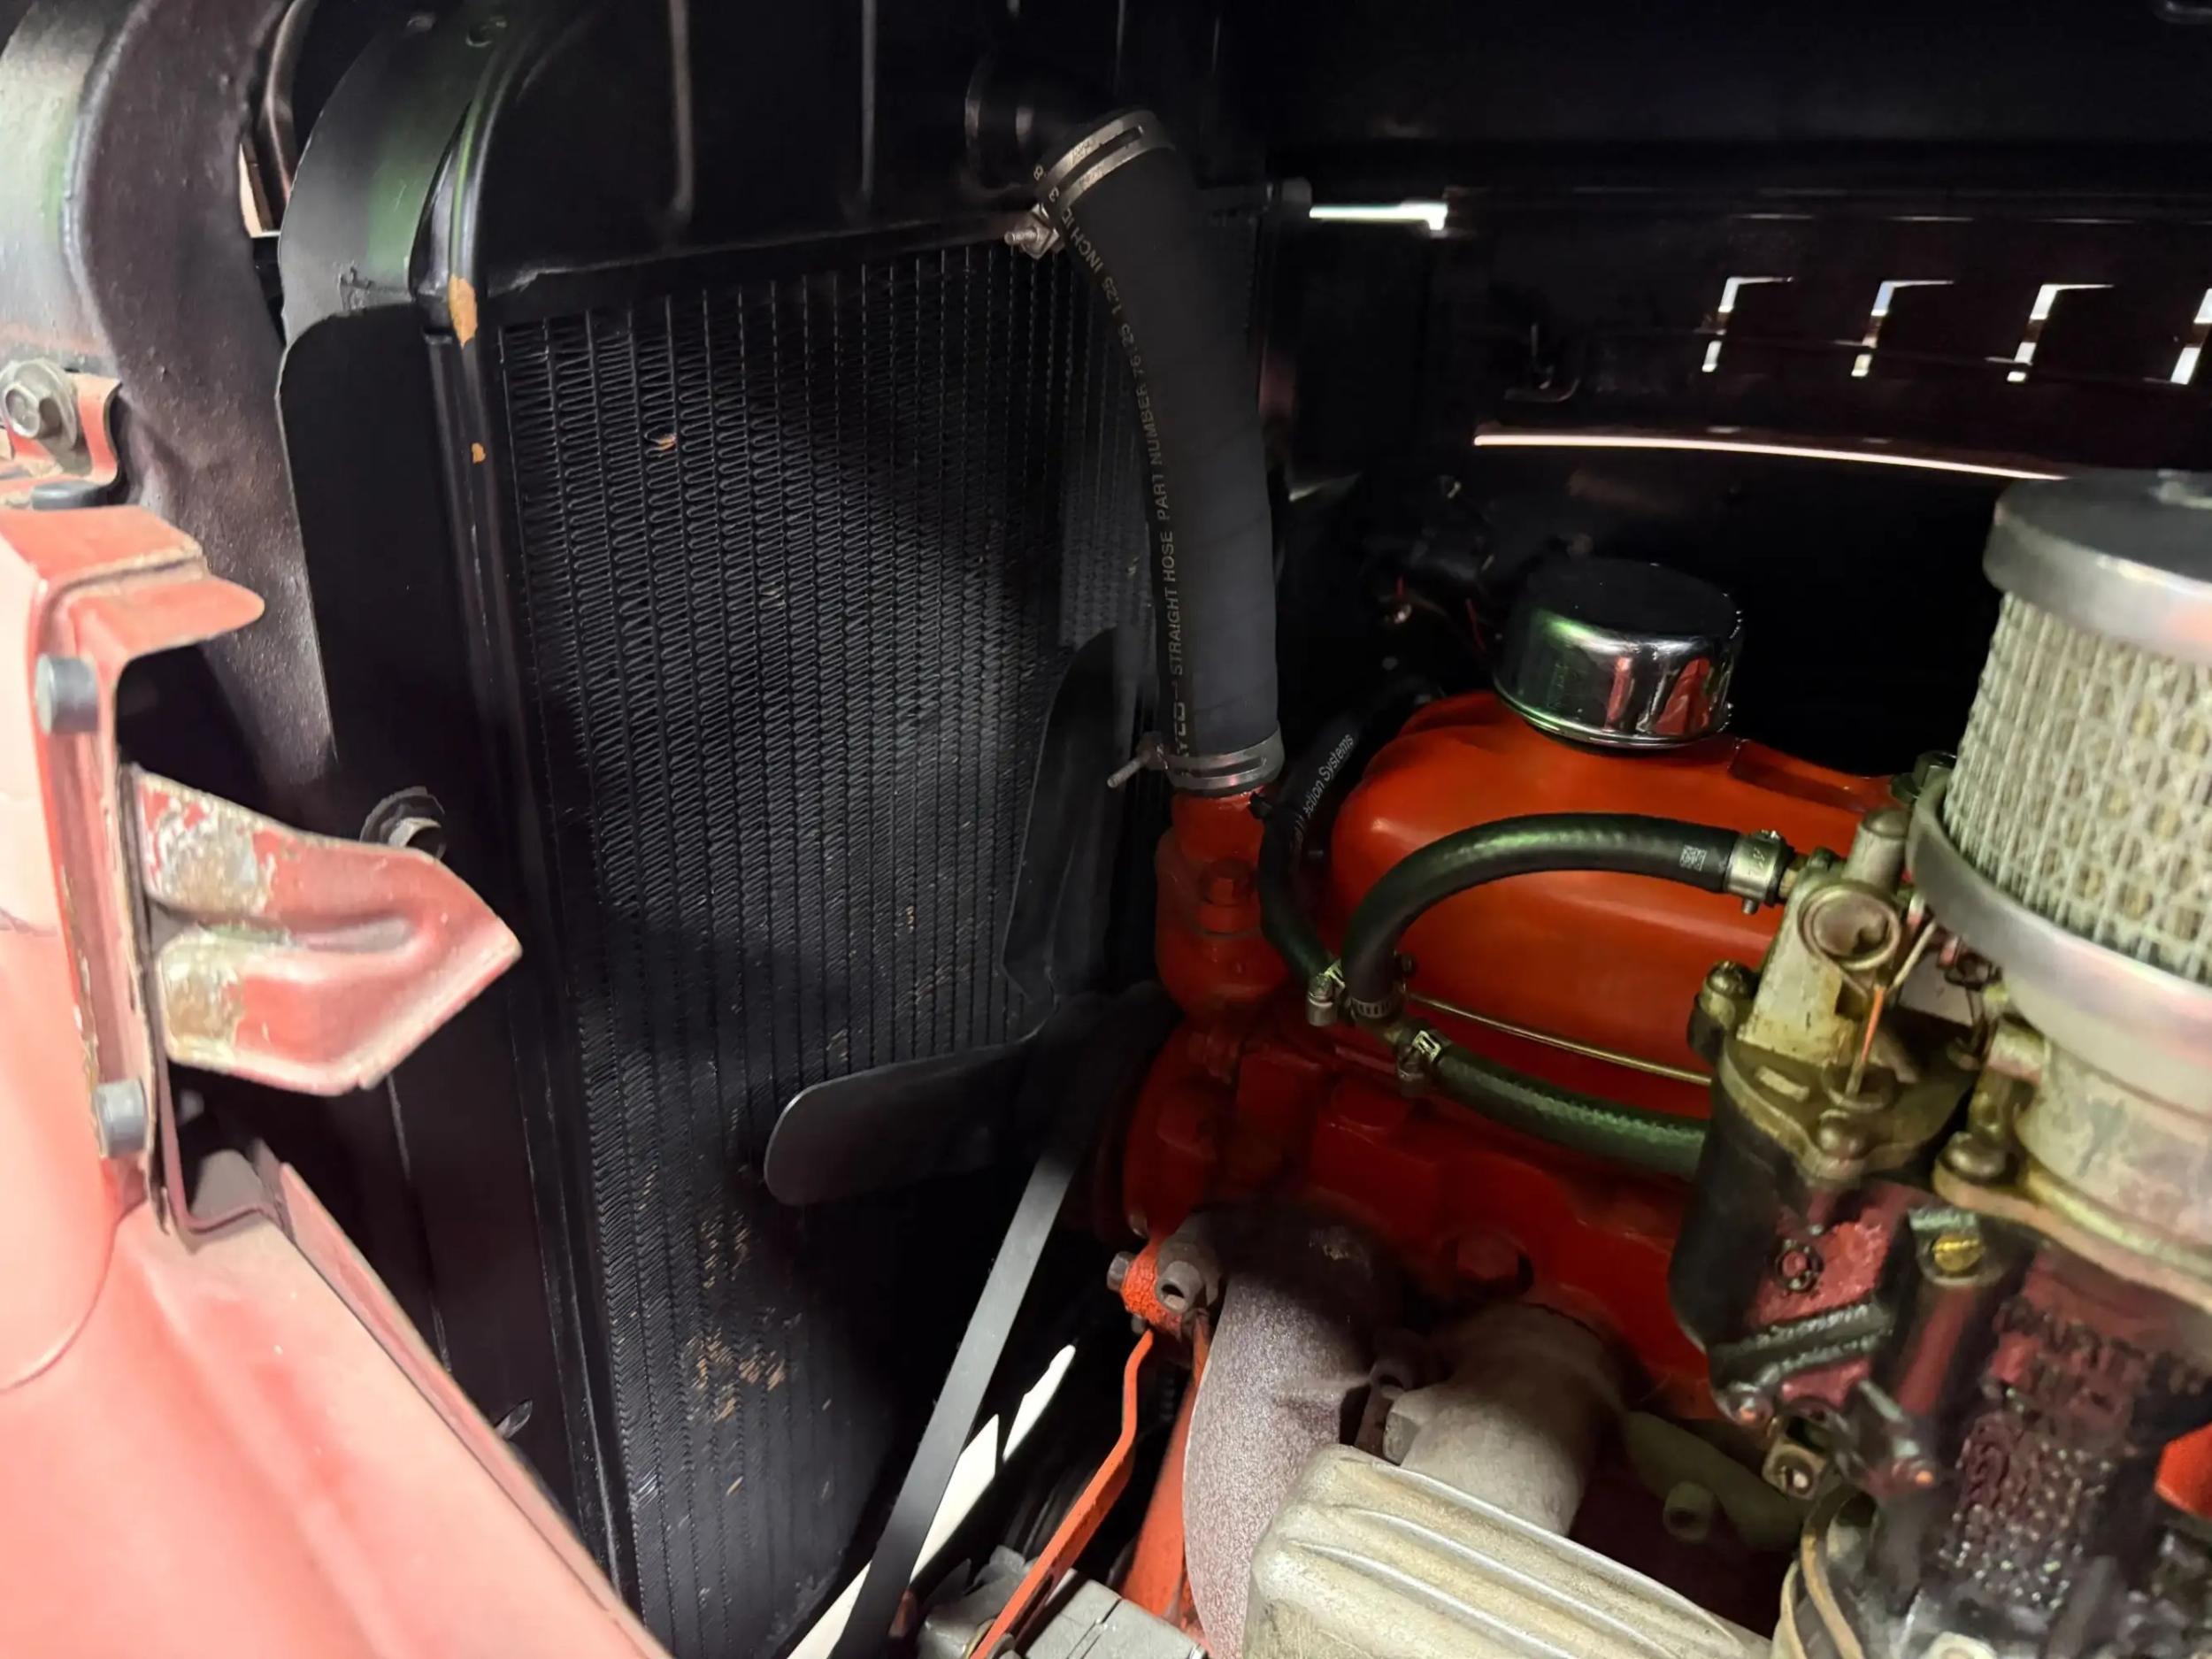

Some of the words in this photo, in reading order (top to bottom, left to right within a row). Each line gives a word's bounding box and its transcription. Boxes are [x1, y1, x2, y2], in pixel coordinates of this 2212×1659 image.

[1070, 227, 1104, 273] INCH
[1102, 277, 1123, 315] 1.25
[1137, 383, 1163, 465] NUMBER
[1152, 472, 1169, 520] PART
[1161, 532, 1177, 581] HOSE
[1164, 587, 1183, 676] STRAIGHT
[1319, 733, 1354, 782] Systems
